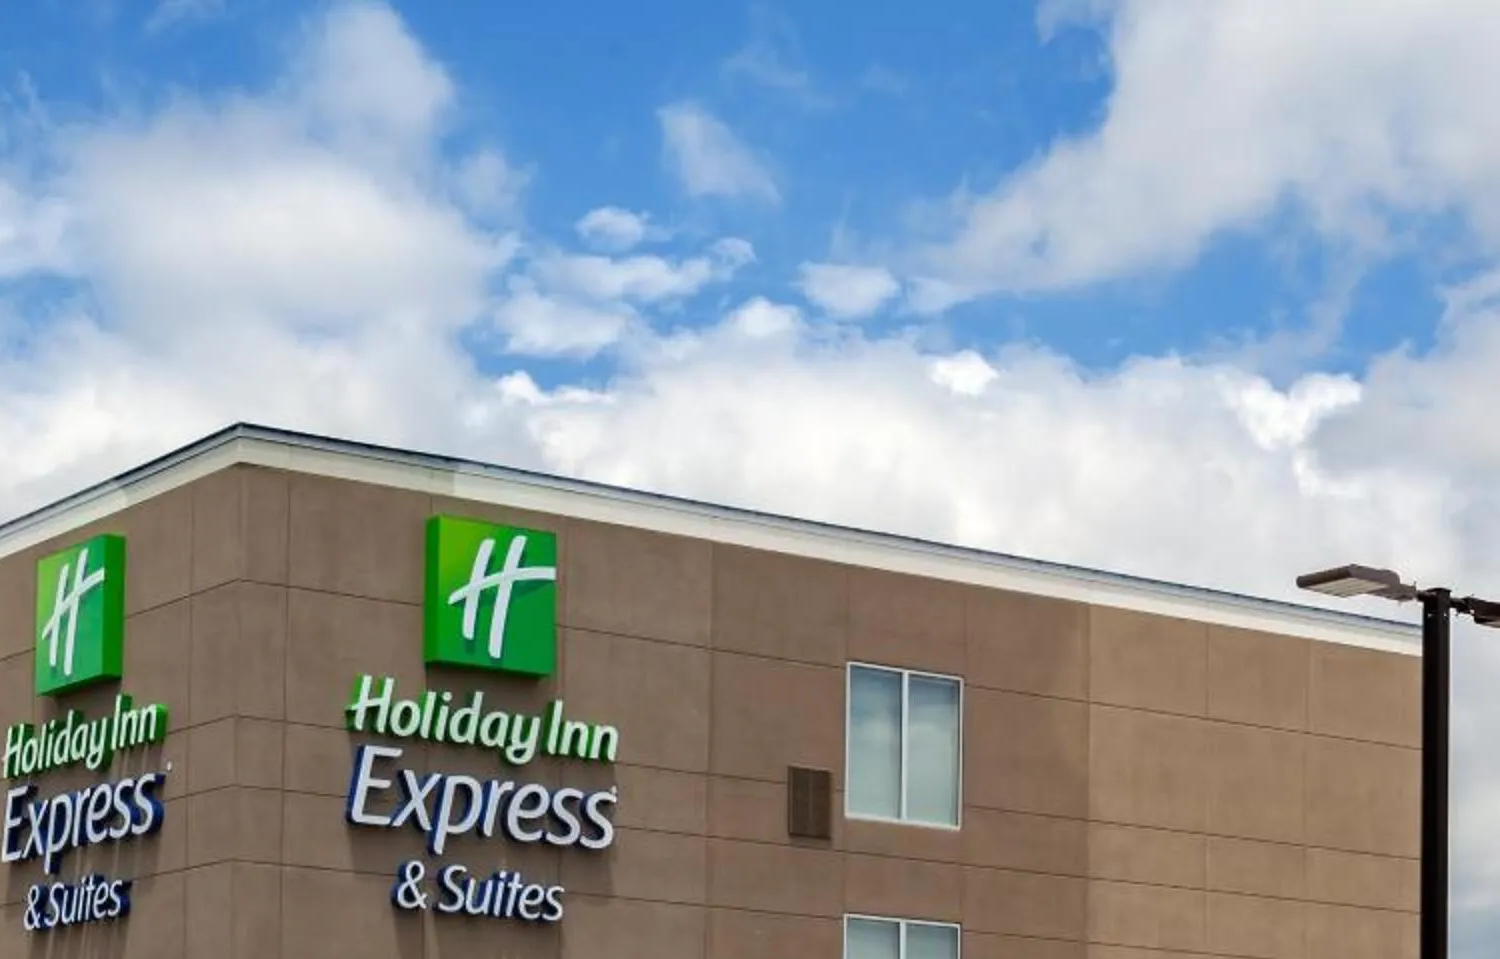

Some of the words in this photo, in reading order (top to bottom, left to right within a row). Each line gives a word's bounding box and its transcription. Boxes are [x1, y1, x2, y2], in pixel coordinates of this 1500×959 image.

[2, 708, 109, 779] Holiday
[111, 695, 160, 752] Inn
[347, 674, 541, 766] Holiday
[544, 699, 618, 762] Inn
[1, 771, 160, 875] Express
[349, 744, 617, 856] Express
[23, 884, 43, 931] &
[43, 874, 124, 927] Suites
[395, 859, 428, 910] &
[439, 864, 565, 922] Suites
